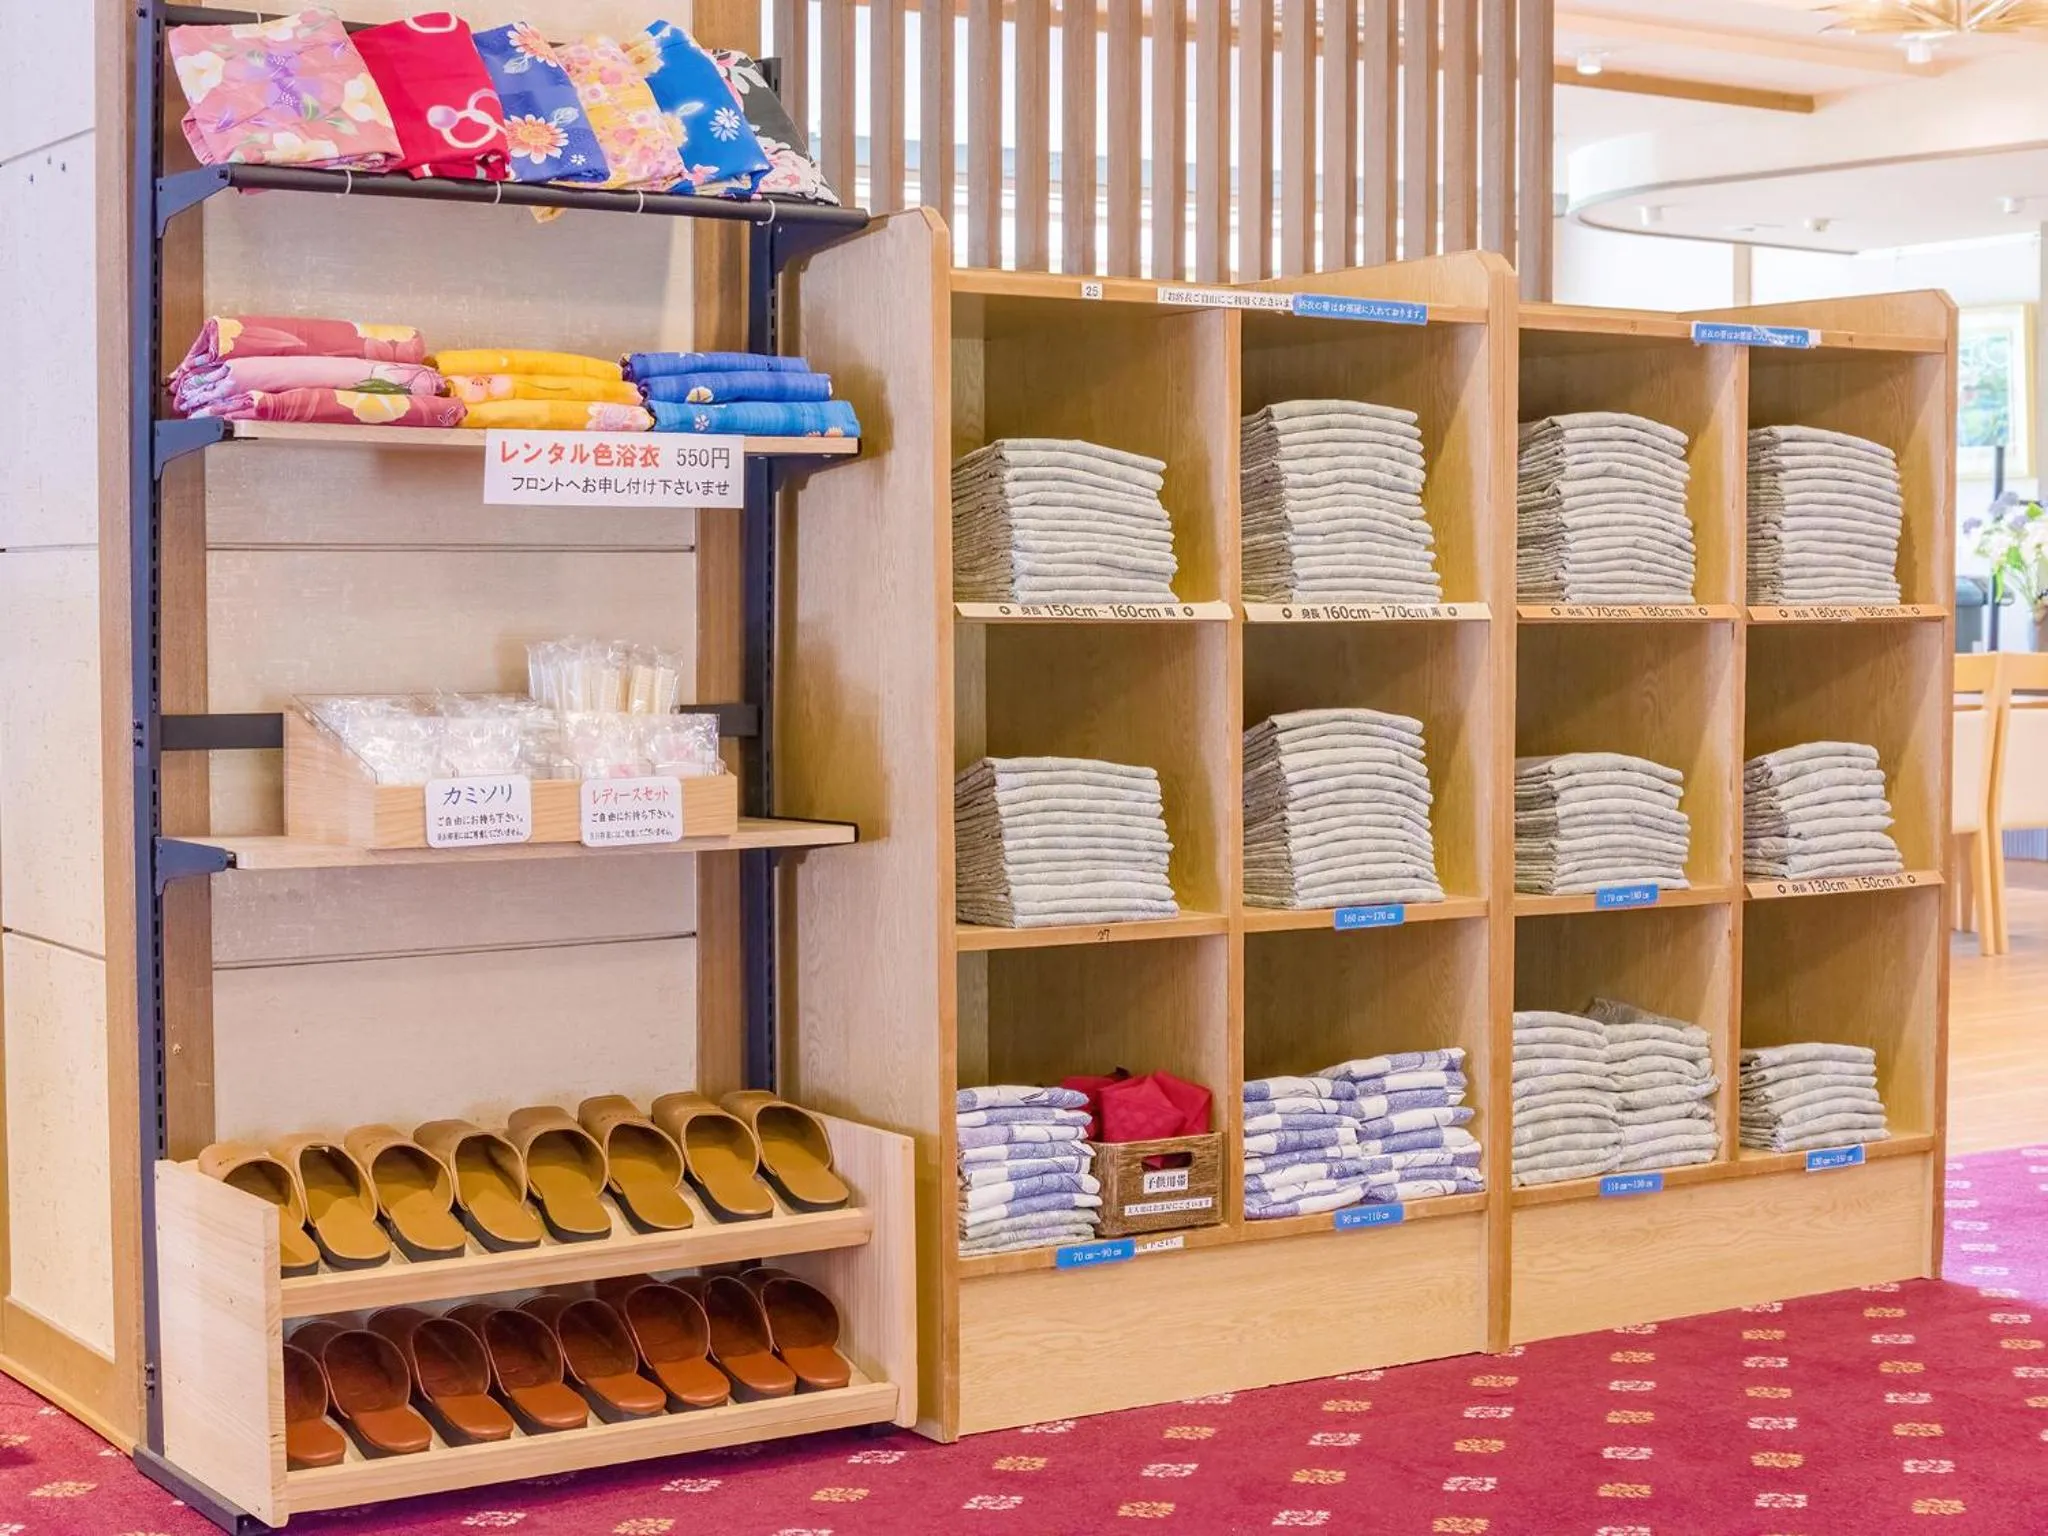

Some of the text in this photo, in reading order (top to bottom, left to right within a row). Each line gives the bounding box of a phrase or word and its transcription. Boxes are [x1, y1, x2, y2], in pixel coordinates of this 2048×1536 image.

[1085, 286, 1099, 297] 25
[501, 441, 730, 470] レンタル色浴衣 550円
[512, 476, 730, 496] フロントへお申し付け下さいませ
[443, 783, 513, 806] カミソリ
[591, 785, 669, 805] レディースセット
[437, 811, 524, 827] ご自由にお持ち下さい。
[591, 808, 675, 823] ご自由にお持ち下さい。
[1148, 1174, 1187, 1190] 子供用帯
